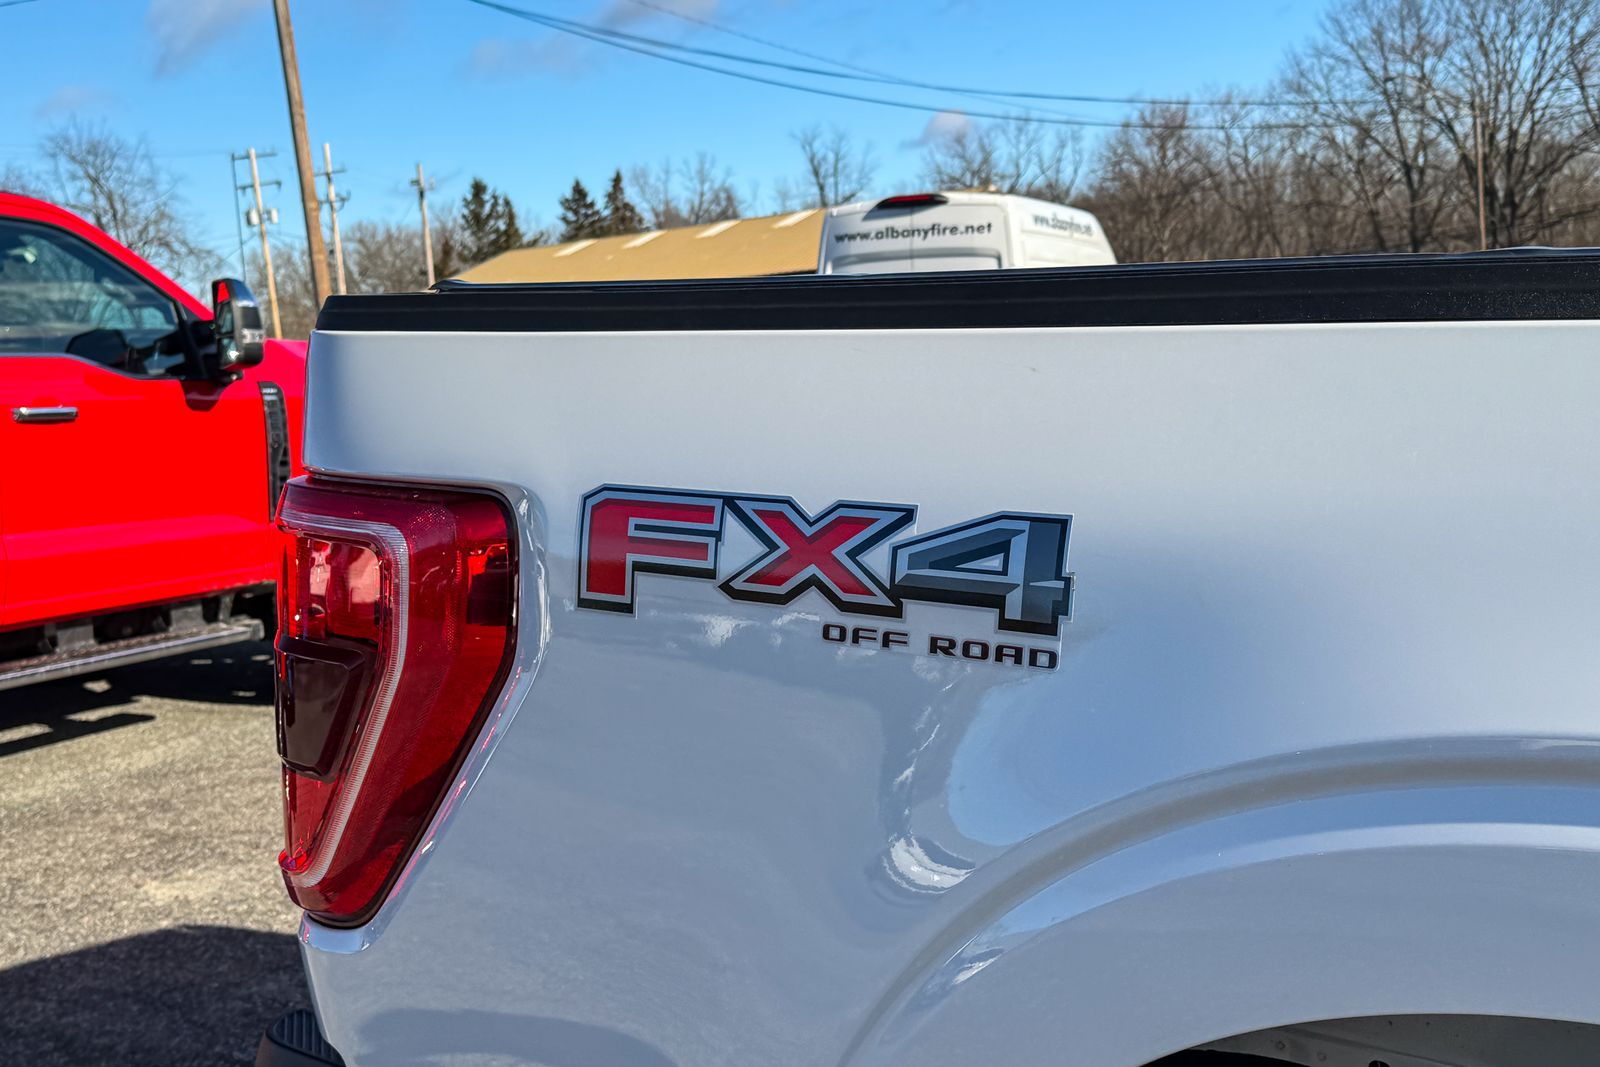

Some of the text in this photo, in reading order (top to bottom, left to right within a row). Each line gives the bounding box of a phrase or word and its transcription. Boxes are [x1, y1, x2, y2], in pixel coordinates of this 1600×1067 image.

[834, 222, 993, 244] www.albanyfire.net
[577, 485, 1072, 637] FX4
[822, 623, 1058, 669] OFF ROAD
